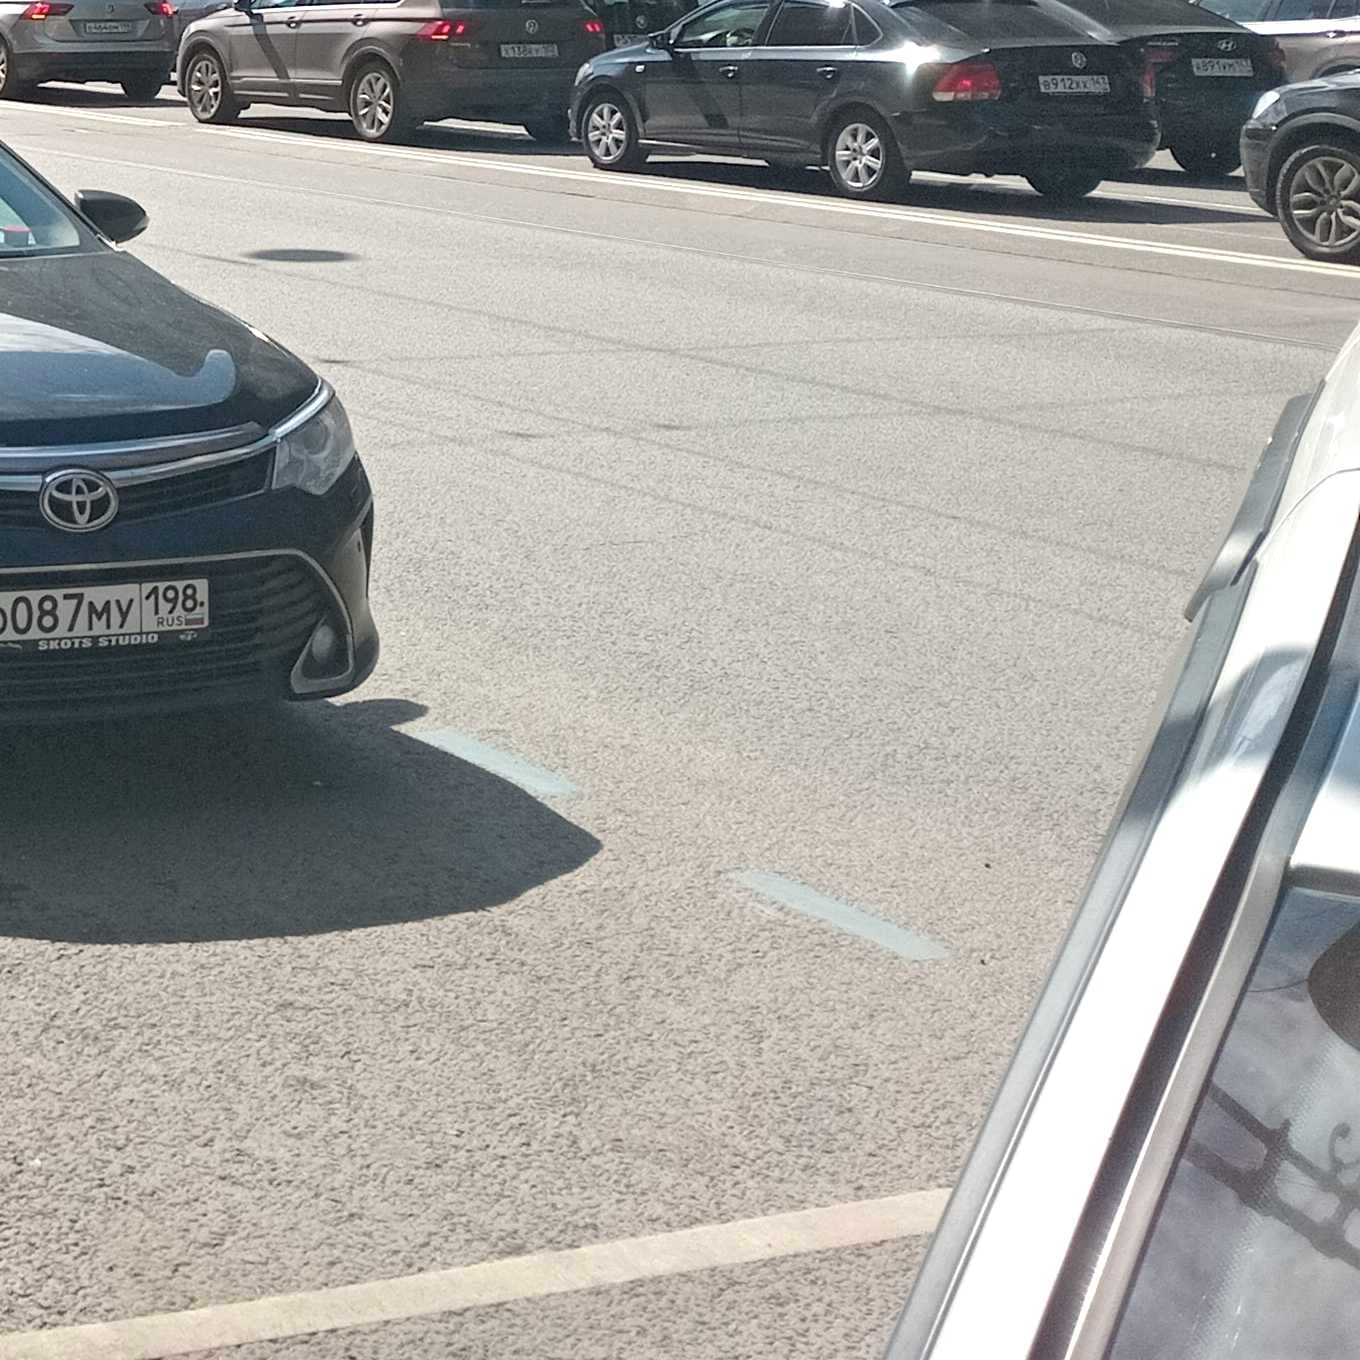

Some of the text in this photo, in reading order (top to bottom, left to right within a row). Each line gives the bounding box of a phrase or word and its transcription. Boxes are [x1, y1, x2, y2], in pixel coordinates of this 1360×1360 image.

[145, 583, 199, 617] 198
[156, 616, 185, 629] RUS
[37, 633, 159, 650] SKOTS STUDIO
